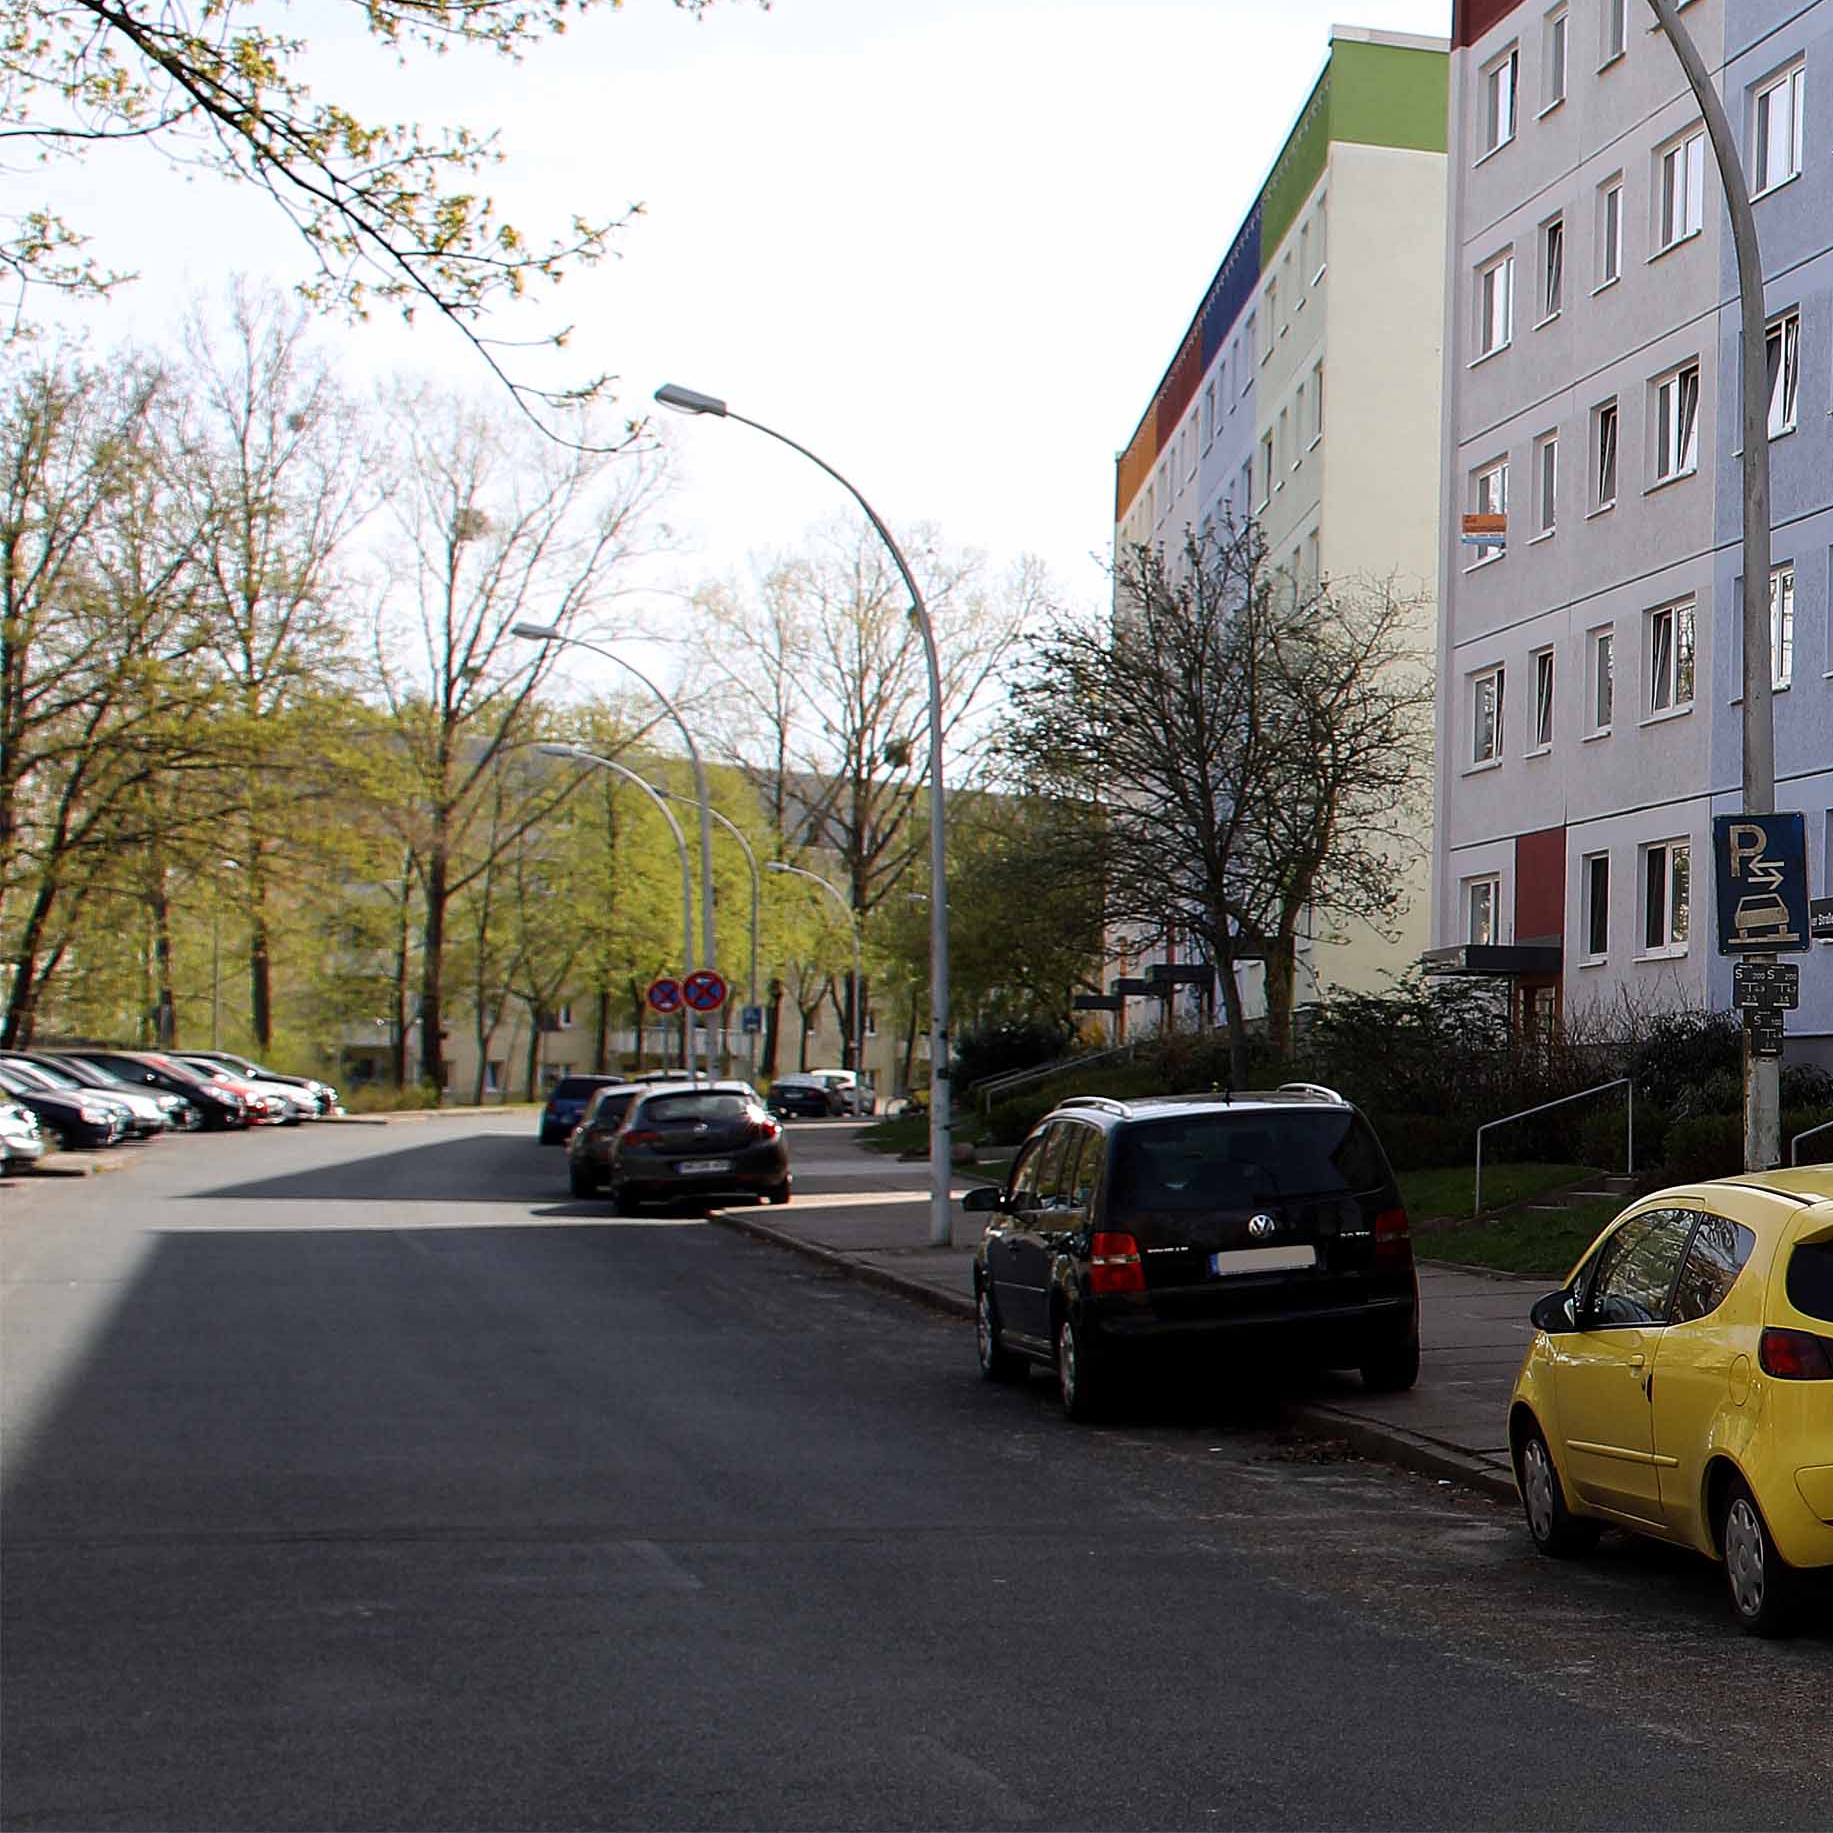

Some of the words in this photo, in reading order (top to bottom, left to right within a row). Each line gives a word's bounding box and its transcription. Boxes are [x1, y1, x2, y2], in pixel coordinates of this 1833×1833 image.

[1729, 824, 1768, 878] P
[1735, 968, 1744, 979] S
[1767, 969, 1776, 980] S
